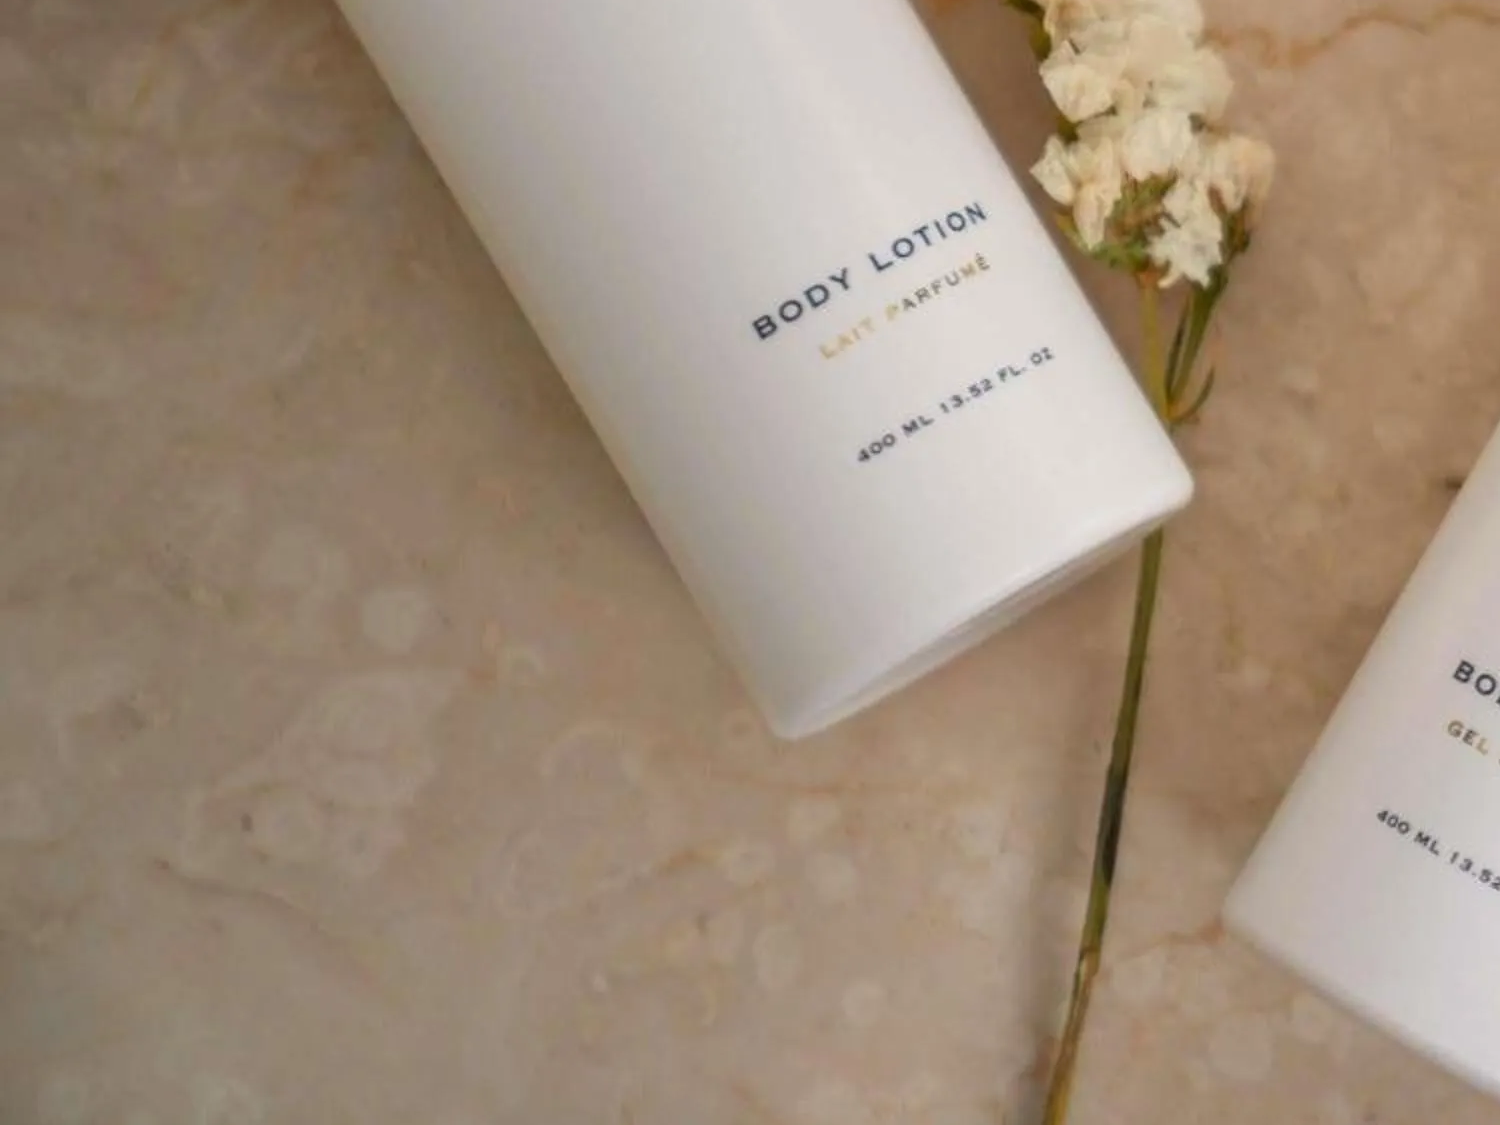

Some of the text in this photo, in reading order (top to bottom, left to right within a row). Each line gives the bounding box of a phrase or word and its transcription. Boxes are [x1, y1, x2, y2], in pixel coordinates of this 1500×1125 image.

[752, 202, 987, 340] BODY LOTION
[819, 252, 991, 360] LAIT PARFUMÉ
[858, 346, 1055, 463] 400 ML 13.52 FL. OZ
[1447, 720, 1489, 756] GEL
[1376, 810, 1410, 835] 400
[1414, 831, 1440, 856] ML
